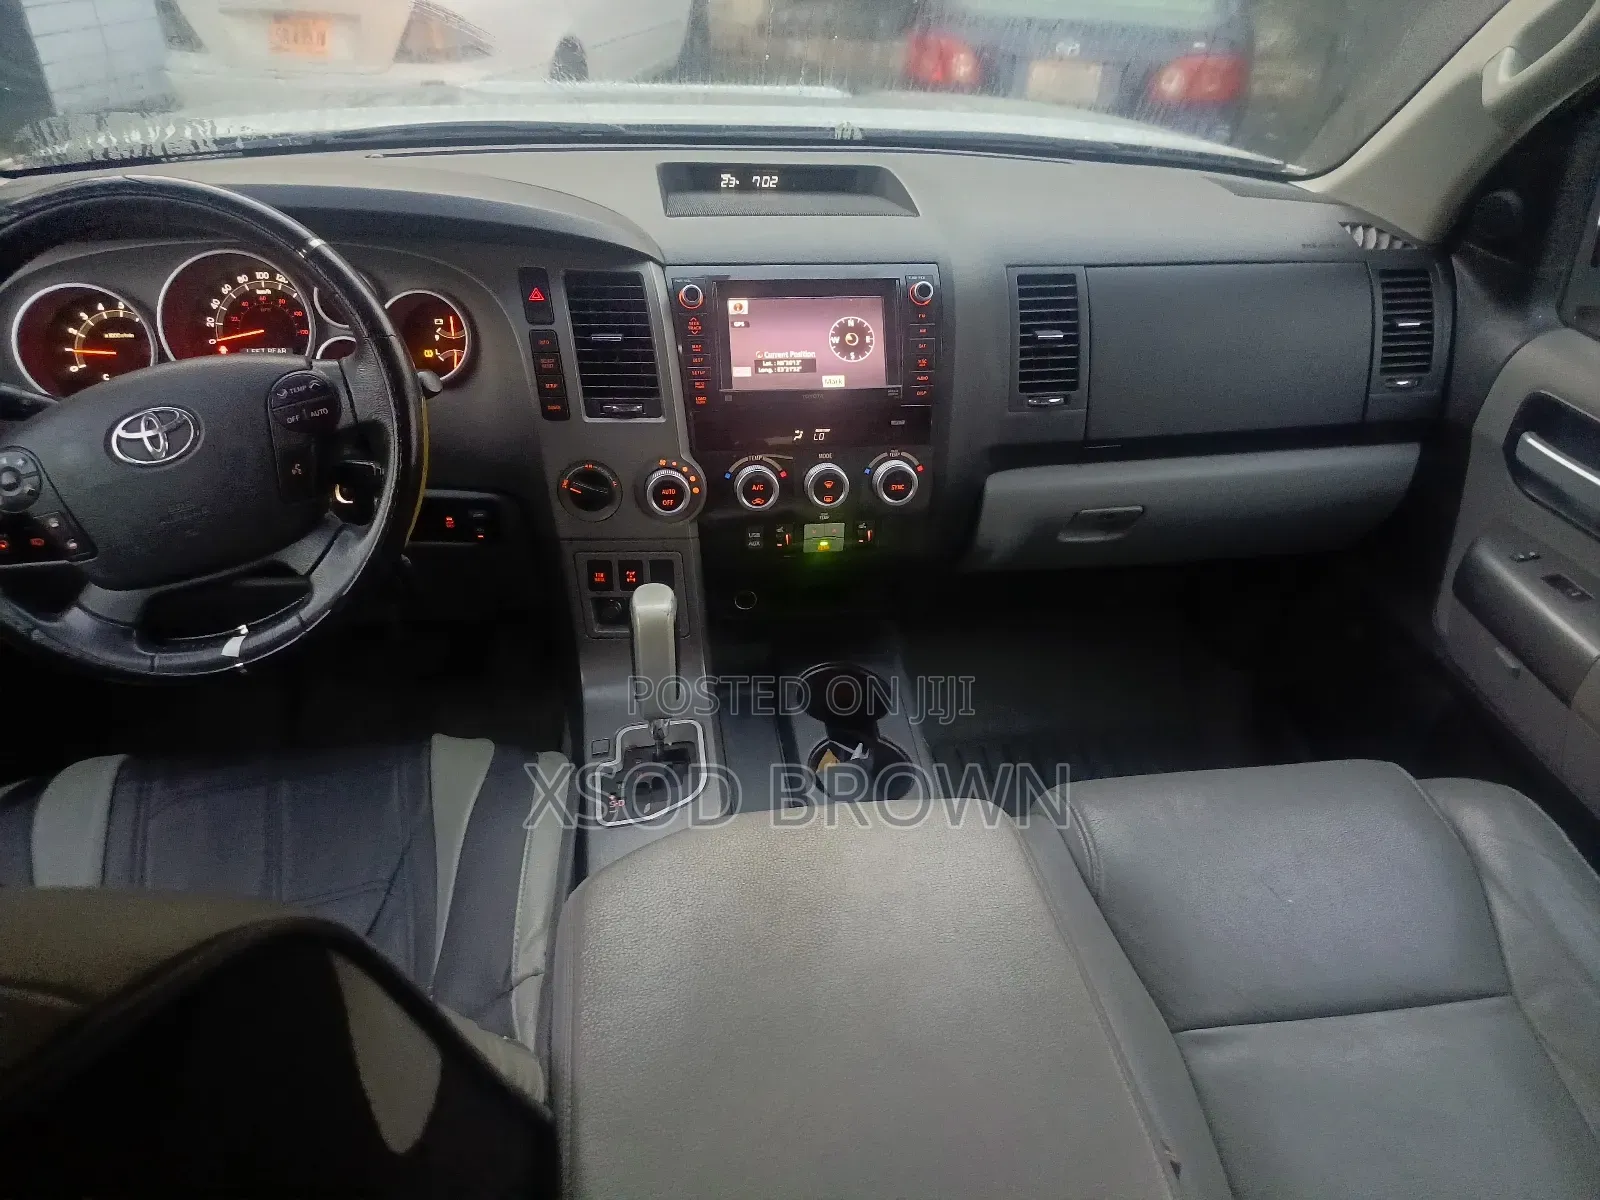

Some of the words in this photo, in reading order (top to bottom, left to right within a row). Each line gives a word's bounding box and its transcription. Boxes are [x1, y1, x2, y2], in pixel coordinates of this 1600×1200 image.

[236, 274, 249, 284] 80
[255, 271, 270, 280] 100
[221, 283, 233, 295] 60
[210, 298, 221, 310] 40
[206, 316, 215, 328] 20
[847, 319, 855, 327] N
[830, 336, 841, 344] W
[865, 335, 871, 344] E
[849, 352, 855, 360] S
[69, 365, 79, 373] 0
[289, 384, 308, 395] TEMP
[286, 414, 301, 425] OFF
[310, 407, 329, 418] AUTO
[818, 452, 833, 460] MODE
[661, 488, 676, 496] AUTO
[751, 483, 764, 492] A/C
[890, 483, 905, 492] SYNC
[662, 499, 674, 507] OFF
